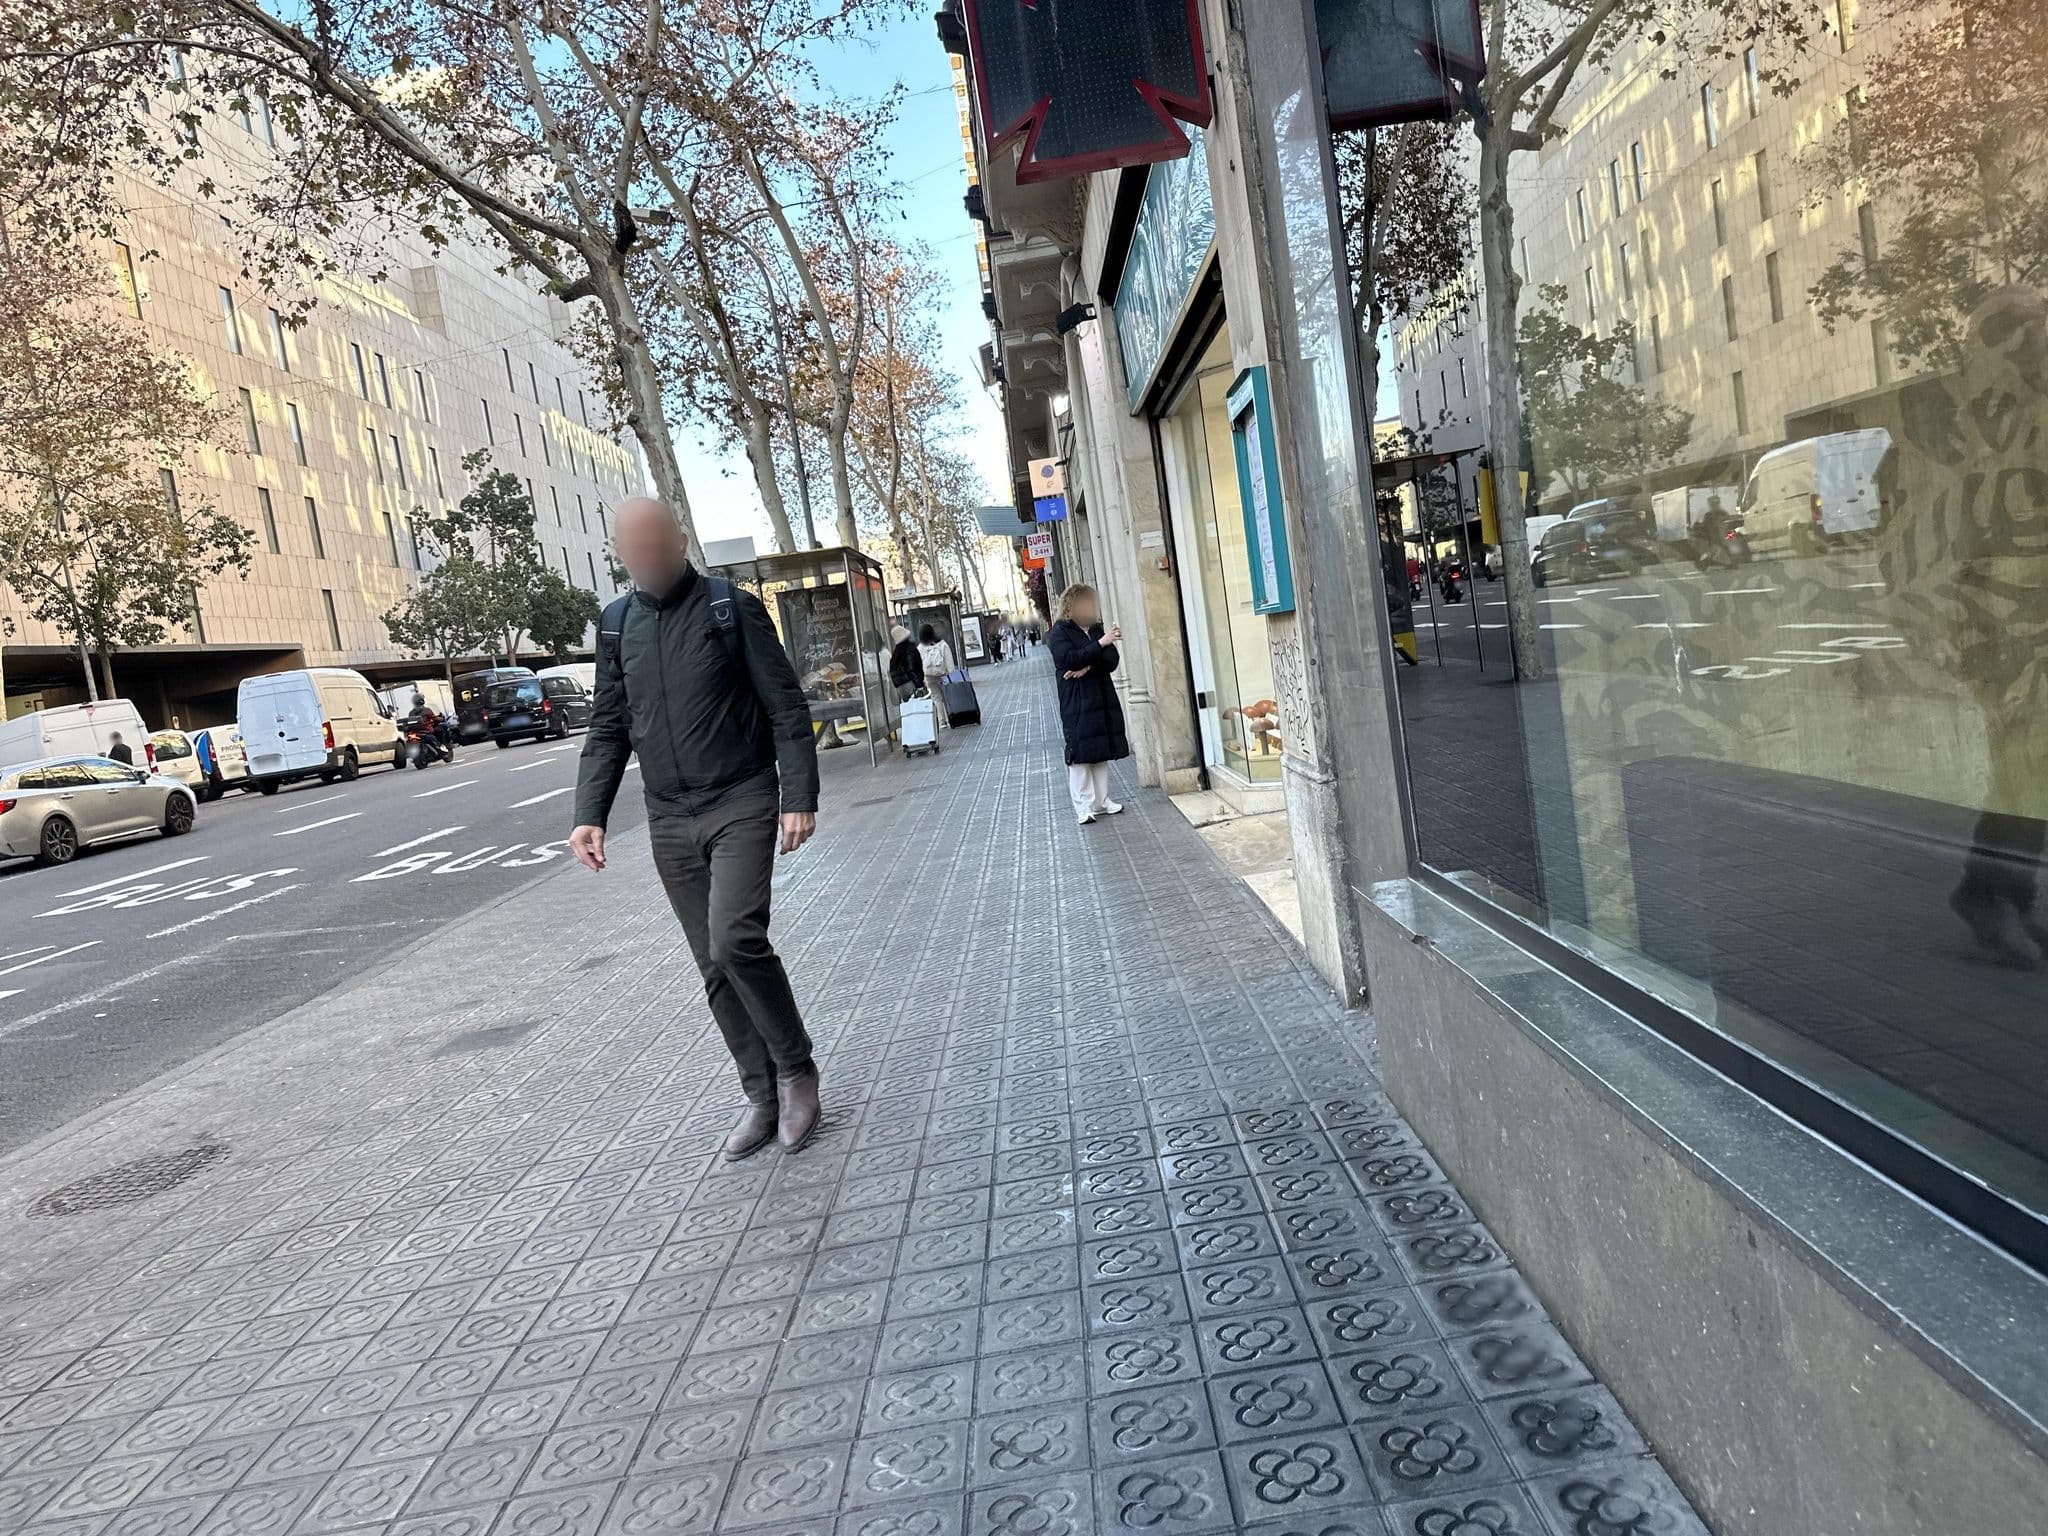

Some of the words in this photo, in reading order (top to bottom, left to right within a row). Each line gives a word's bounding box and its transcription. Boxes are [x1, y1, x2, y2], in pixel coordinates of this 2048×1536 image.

[1028, 534, 1051, 546] SUPER
[349, 839, 571, 883] BUS
[32, 867, 303, 918] BUS
